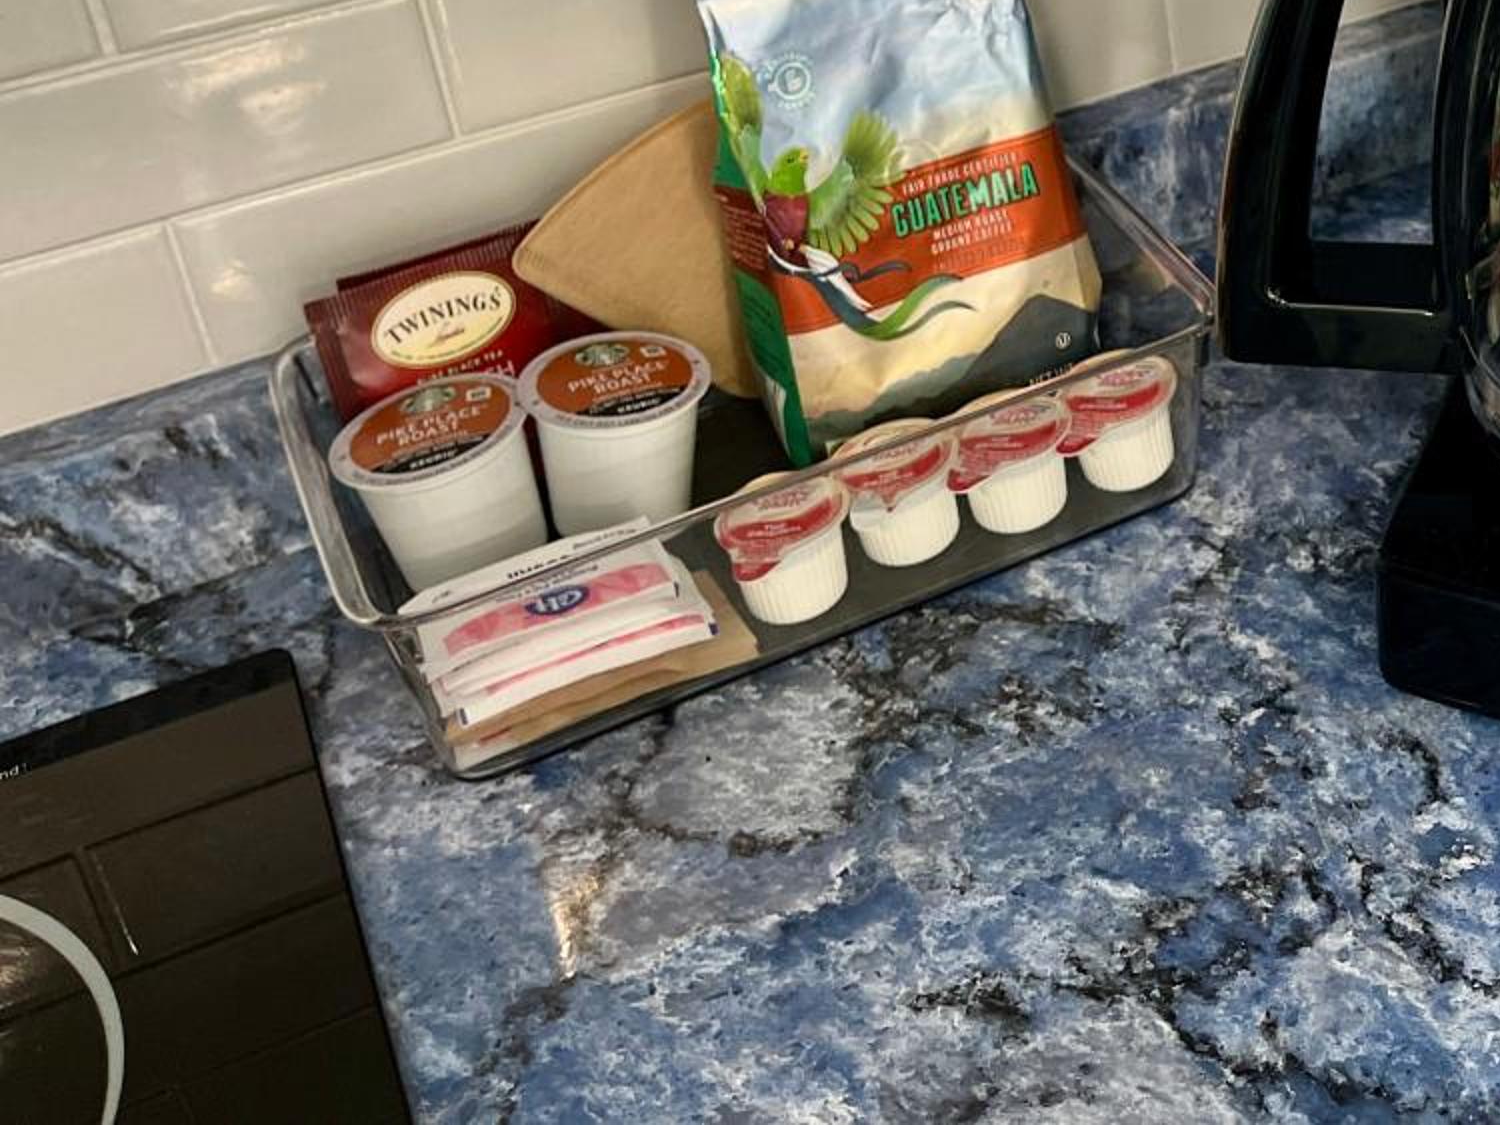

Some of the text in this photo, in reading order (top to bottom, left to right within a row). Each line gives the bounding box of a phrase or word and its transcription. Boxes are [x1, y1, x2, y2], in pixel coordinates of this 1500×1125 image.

[891, 163, 1038, 237] GUATEMALA
[383, 291, 502, 344] TWININGS
[566, 371, 609, 393] PIKE
[613, 360, 668, 380] PLACE
[592, 372, 653, 394] ROAST
[376, 405, 482, 445] PIKE PLACE
[398, 421, 459, 446] ROAST
